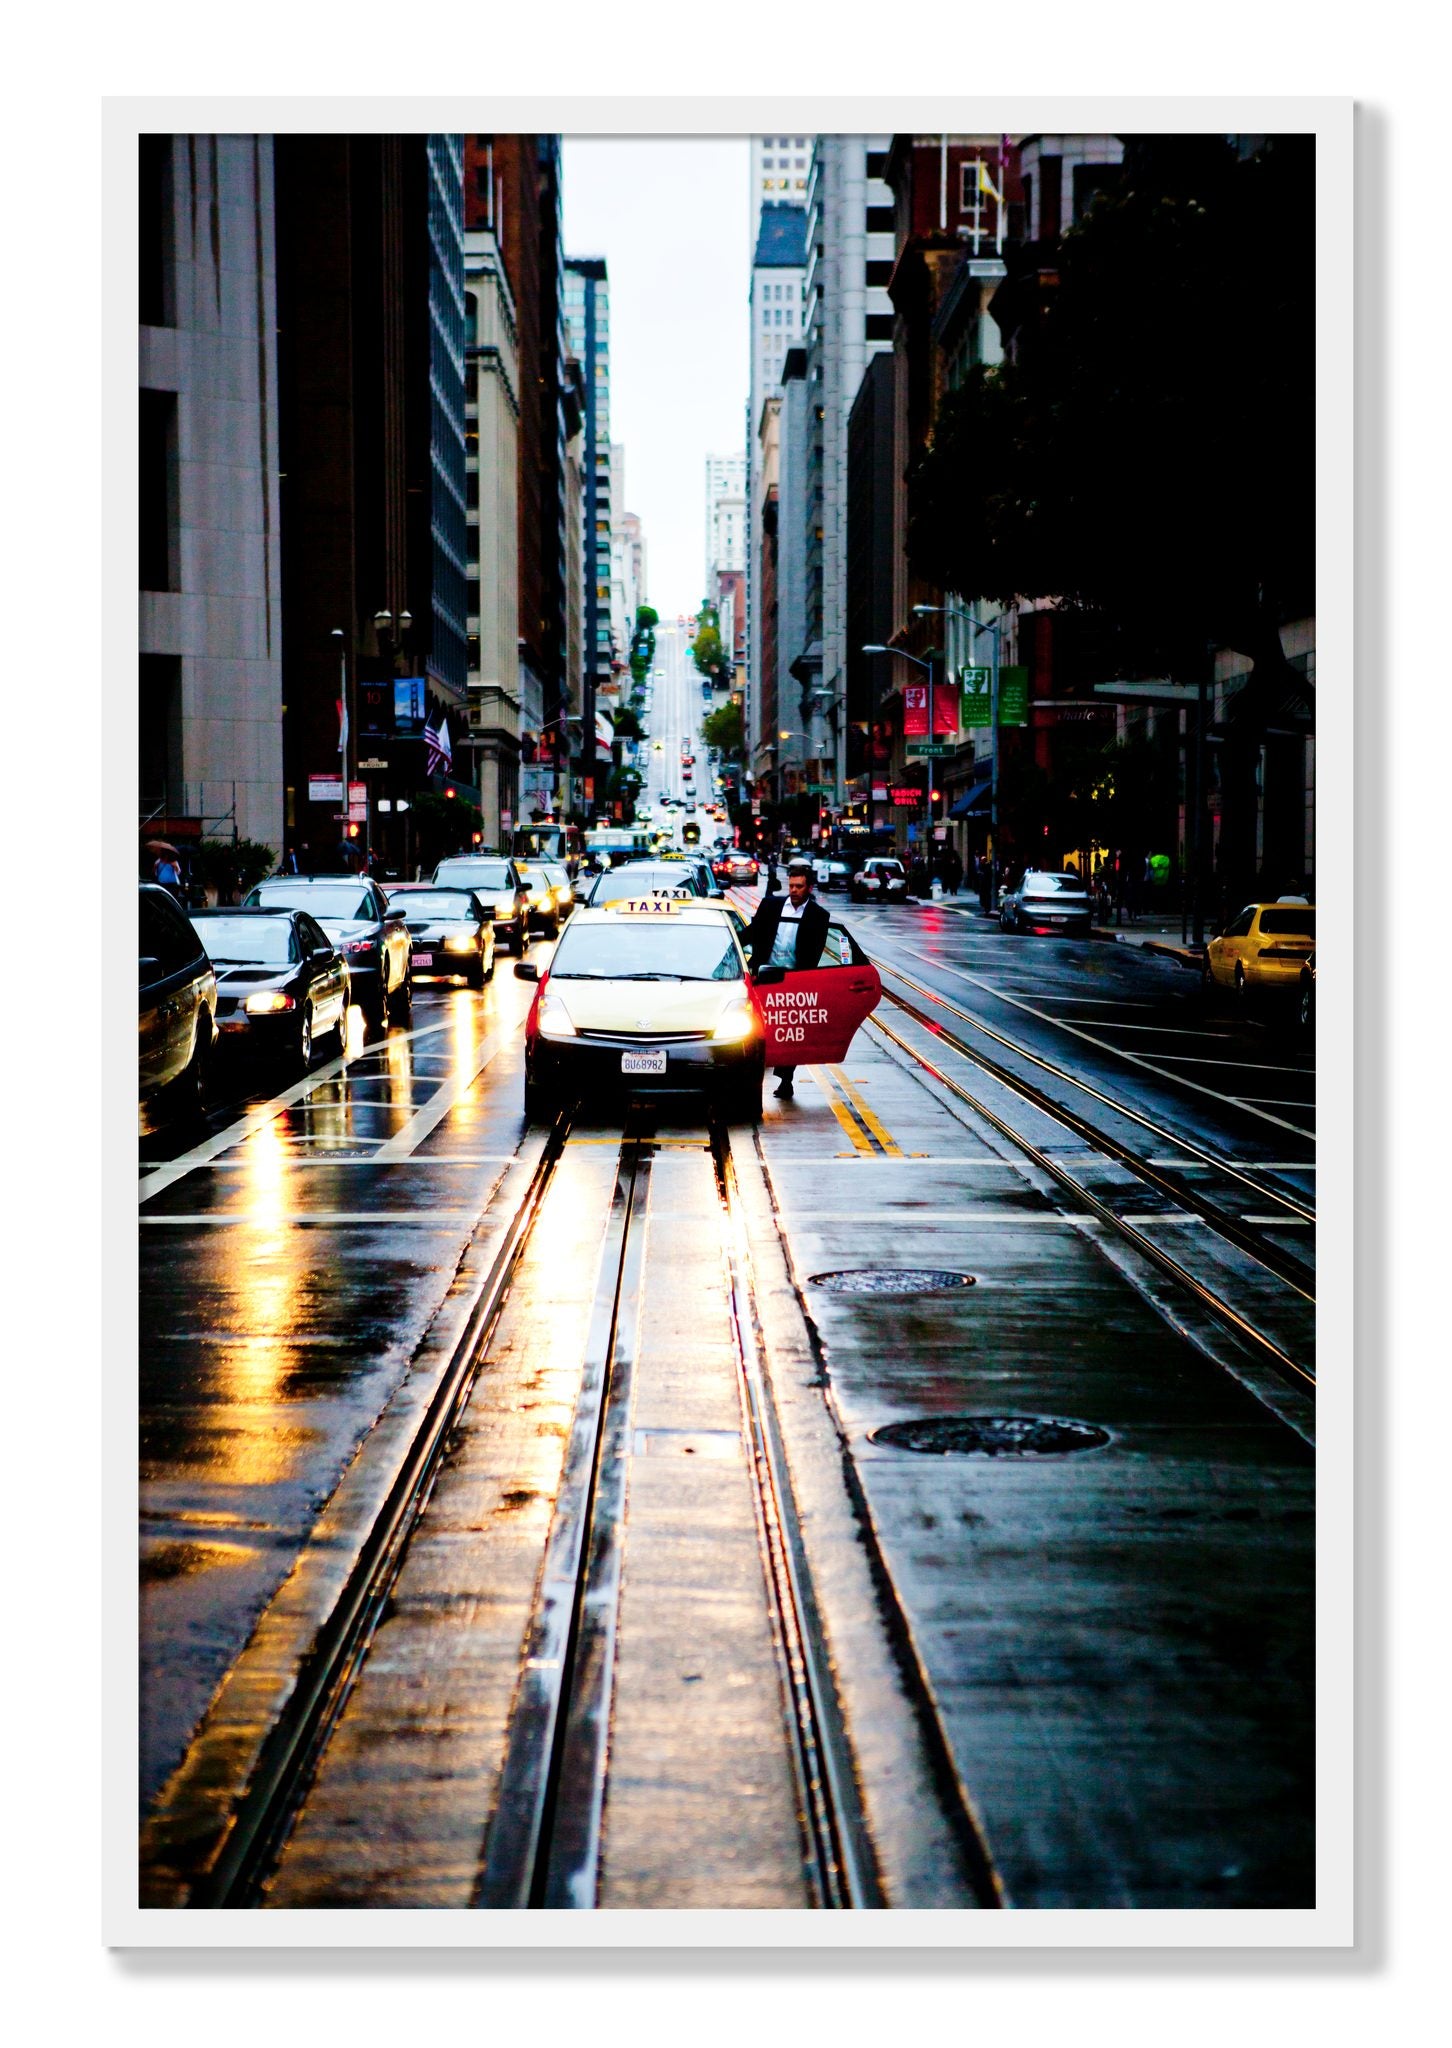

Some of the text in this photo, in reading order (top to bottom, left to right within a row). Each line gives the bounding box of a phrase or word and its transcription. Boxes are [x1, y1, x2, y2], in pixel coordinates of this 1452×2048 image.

[890, 788, 922, 797] TADICH
[652, 889, 688, 899] TAXI
[628, 901, 671, 912] TAXI
[765, 992, 818, 1007] ARROW
[775, 1027, 805, 1042] CAB
